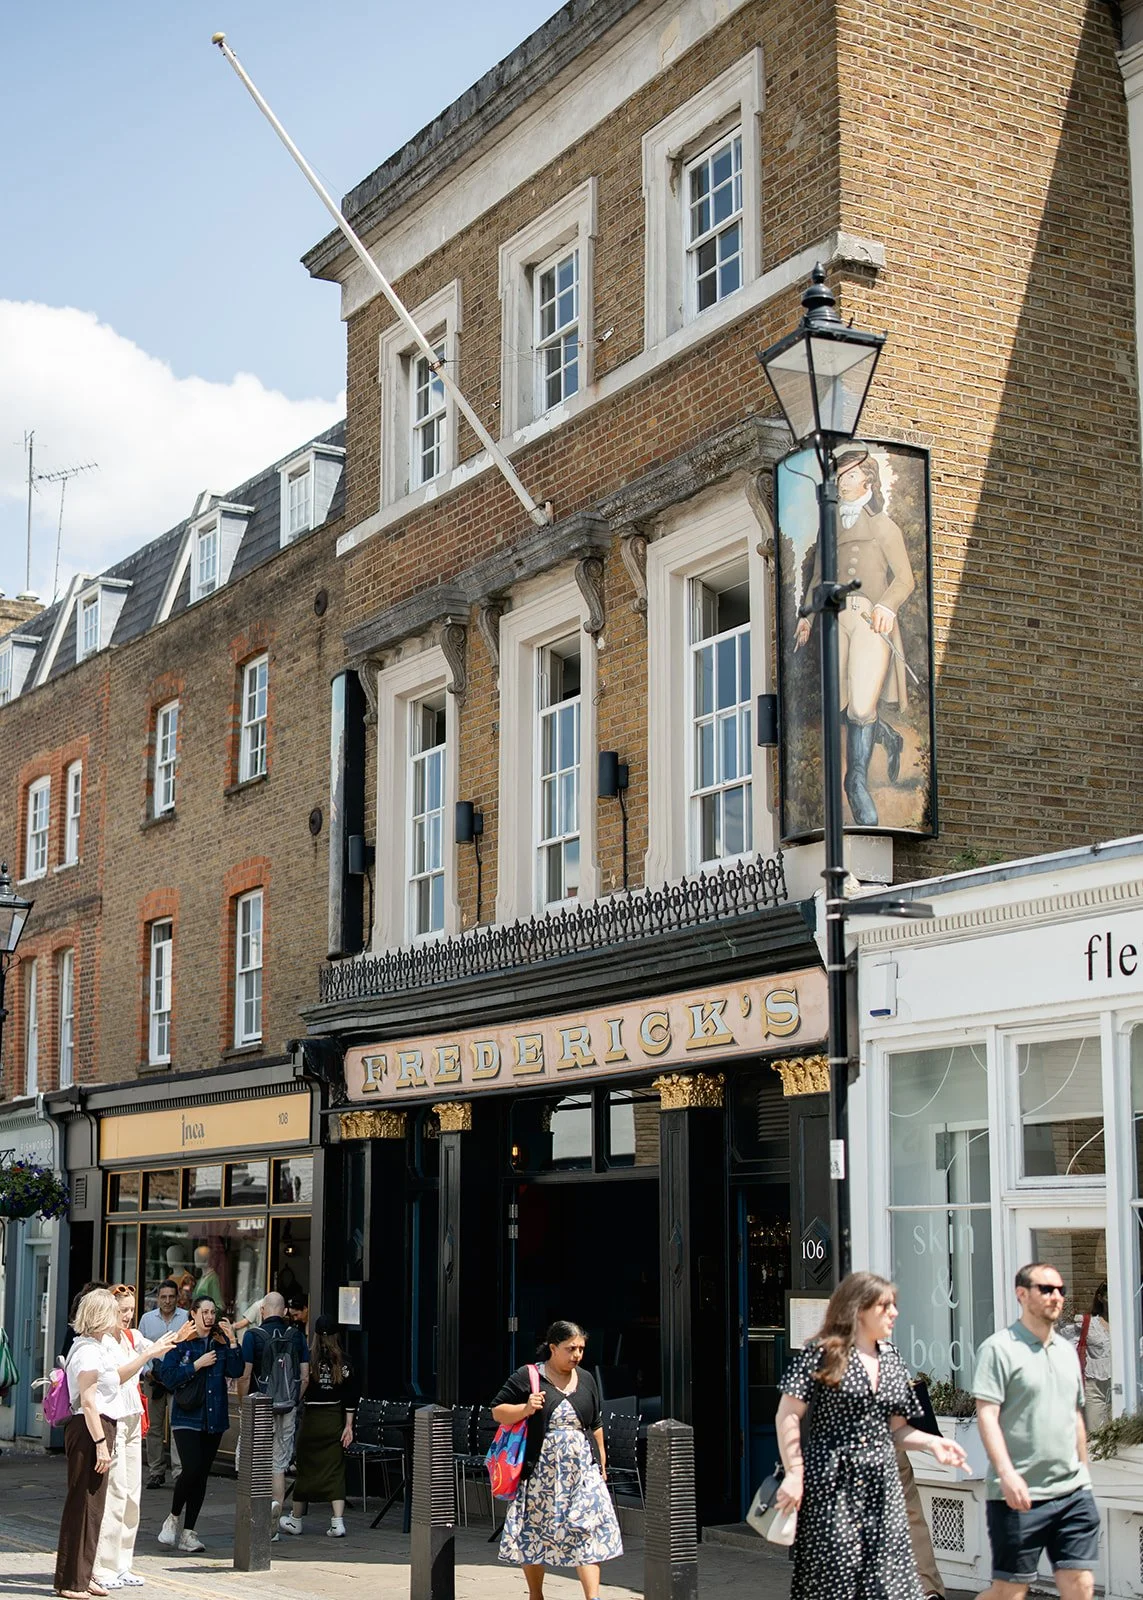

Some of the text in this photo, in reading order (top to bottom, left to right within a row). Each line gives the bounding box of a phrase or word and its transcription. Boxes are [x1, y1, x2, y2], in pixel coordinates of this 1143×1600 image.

[1084, 931, 1143, 981] fle
[362, 987, 804, 1094] FREDERICK'S
[802, 1239, 824, 1259] 106
[912, 1210, 975, 1255] skin
[931, 1267, 960, 1309] &
